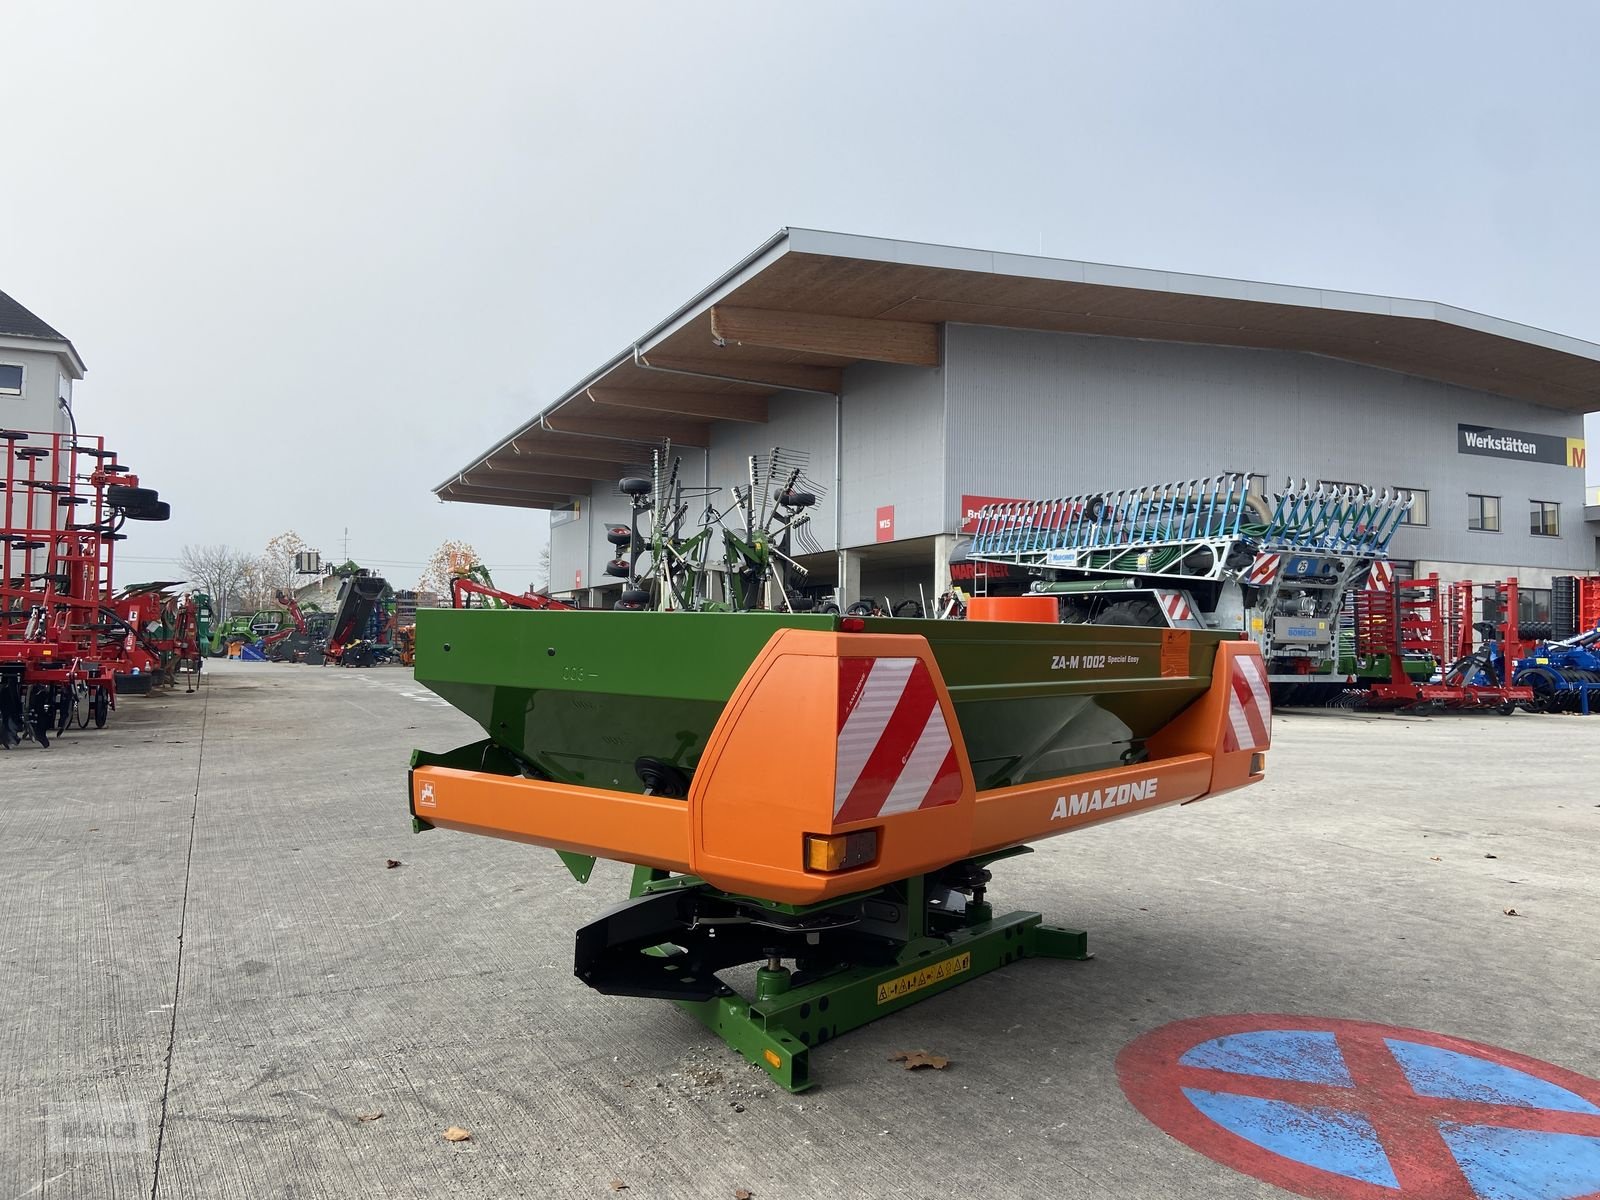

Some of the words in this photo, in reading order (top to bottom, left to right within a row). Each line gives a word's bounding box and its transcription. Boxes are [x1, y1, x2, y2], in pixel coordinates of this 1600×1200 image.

[1465, 431, 1537, 455] Werkstätten
[1051, 655, 1080, 670] ZA-M
[1082, 655, 1106, 669] 1002
[1107, 655, 1127, 664] Special
[1127, 655, 1140, 665] Easy
[1050, 777, 1159, 821] AMAZONE
